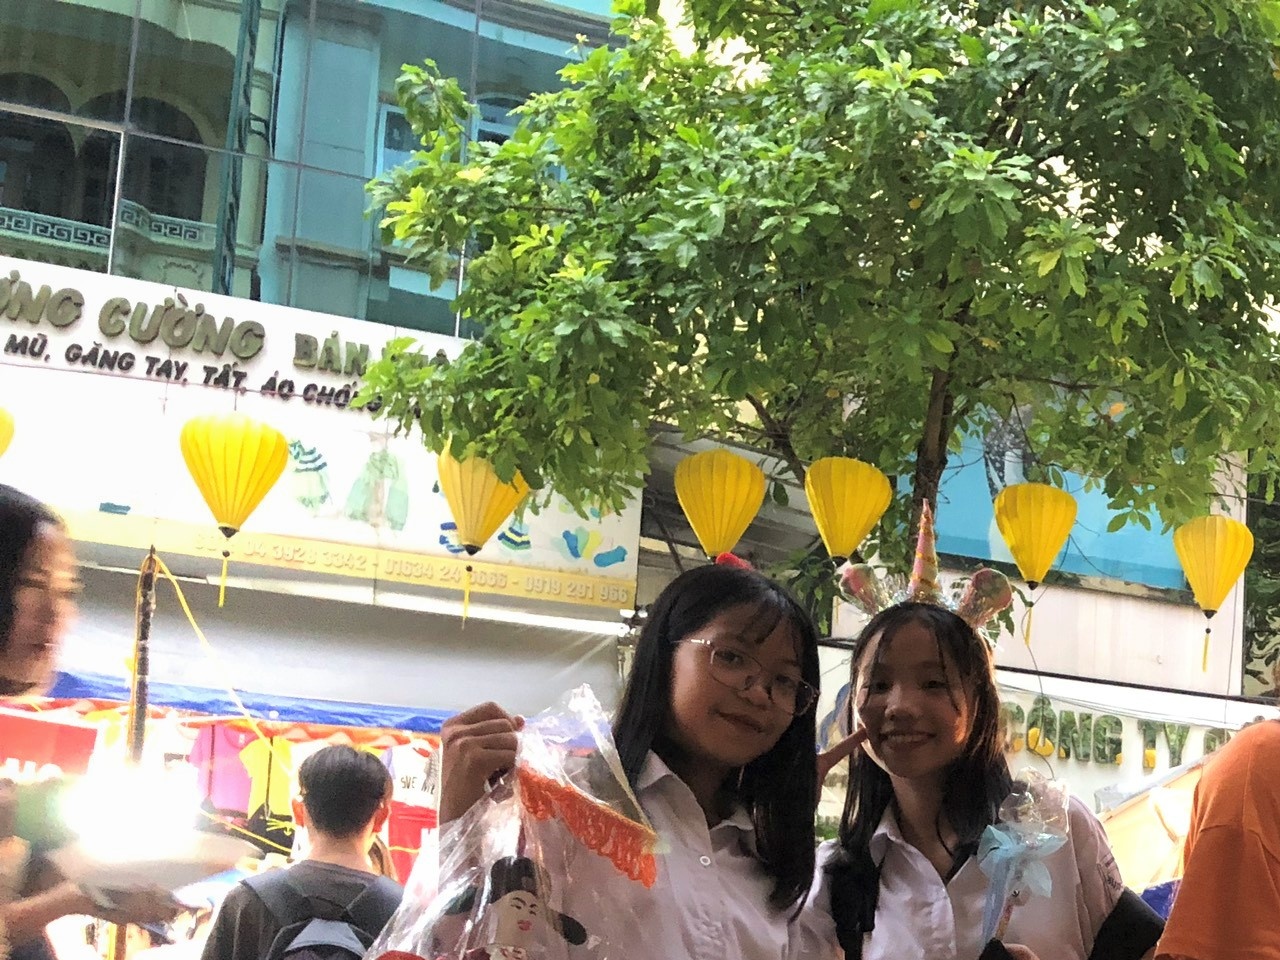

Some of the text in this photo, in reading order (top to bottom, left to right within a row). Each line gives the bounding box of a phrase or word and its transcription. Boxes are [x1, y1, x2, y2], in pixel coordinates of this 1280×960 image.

[98, 292, 266, 360] CƯỜNG
[65, 341, 136, 372] GĂNG
[260, 370, 295, 399] ÁO
[1137, 718, 1192, 769] TY
